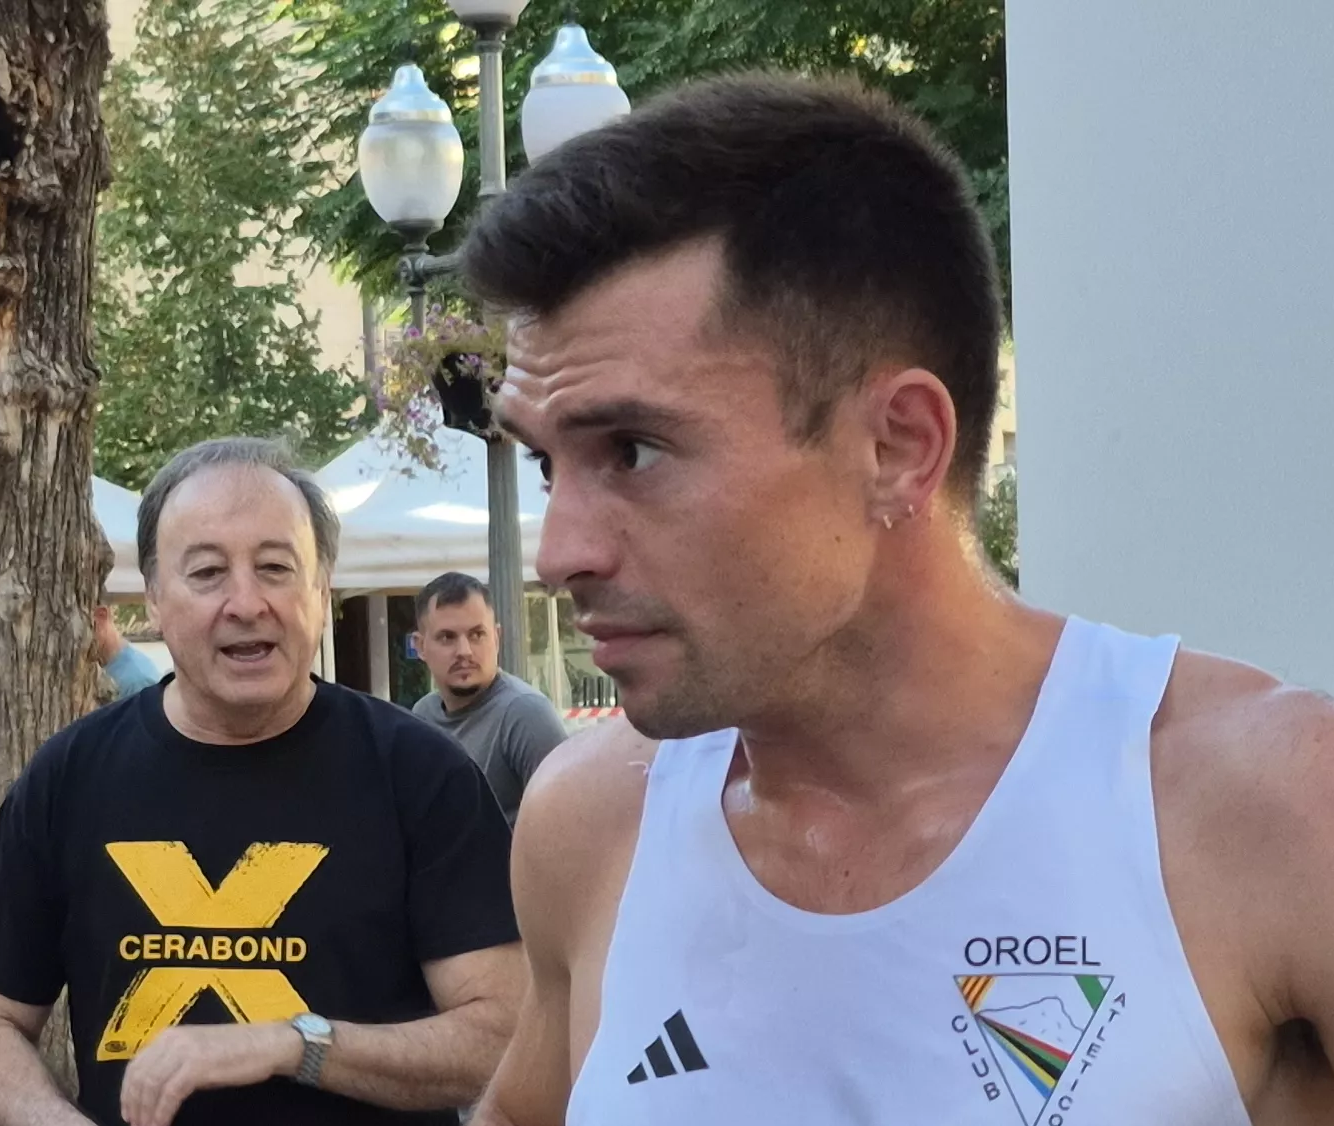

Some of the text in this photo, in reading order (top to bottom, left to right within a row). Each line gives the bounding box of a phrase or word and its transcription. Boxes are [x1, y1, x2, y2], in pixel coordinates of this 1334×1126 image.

[118, 933, 308, 963] CERABOND
[964, 935, 1101, 967] OROEL
[951, 1014, 1001, 1102] CLUB
